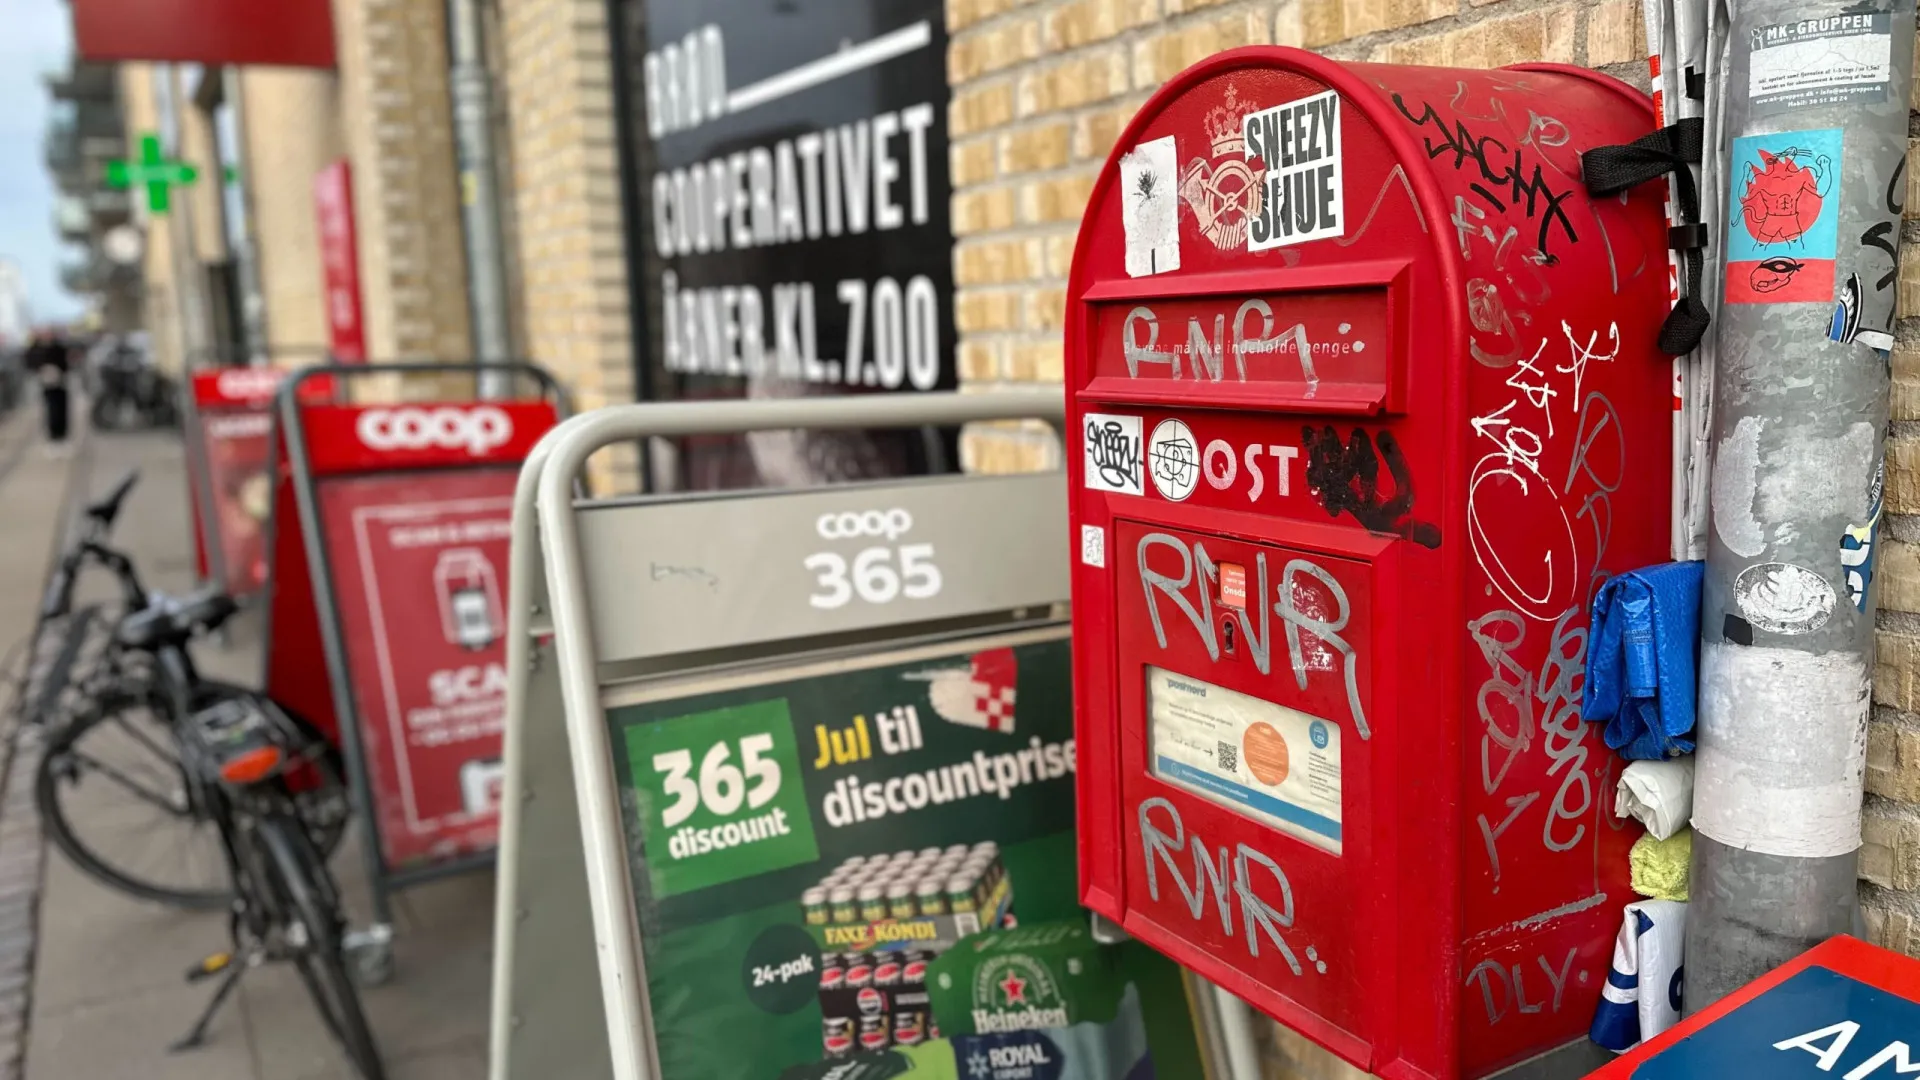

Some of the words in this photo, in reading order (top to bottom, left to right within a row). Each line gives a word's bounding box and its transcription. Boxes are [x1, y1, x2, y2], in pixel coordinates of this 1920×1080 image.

[1767, 15, 1873, 40] MK-GRUPPEN
[1246, 94, 1338, 173] SNEEZY
[837, 275, 940, 391] 7.00
[356, 406, 513, 456] coop
[817, 508, 913, 541] coop
[804, 542, 943, 609] 365
[814, 716, 872, 770] Jul
[876, 705, 923, 757] til
[652, 732, 781, 829] 365
[668, 808, 791, 860] discount
[824, 926, 867, 945] FAXE
[873, 922, 937, 942] KONDI
[752, 953, 815, 988] 24-pak
[971, 1004, 1068, 1034] Heineken
[988, 1043, 1050, 1068] ROYAL
